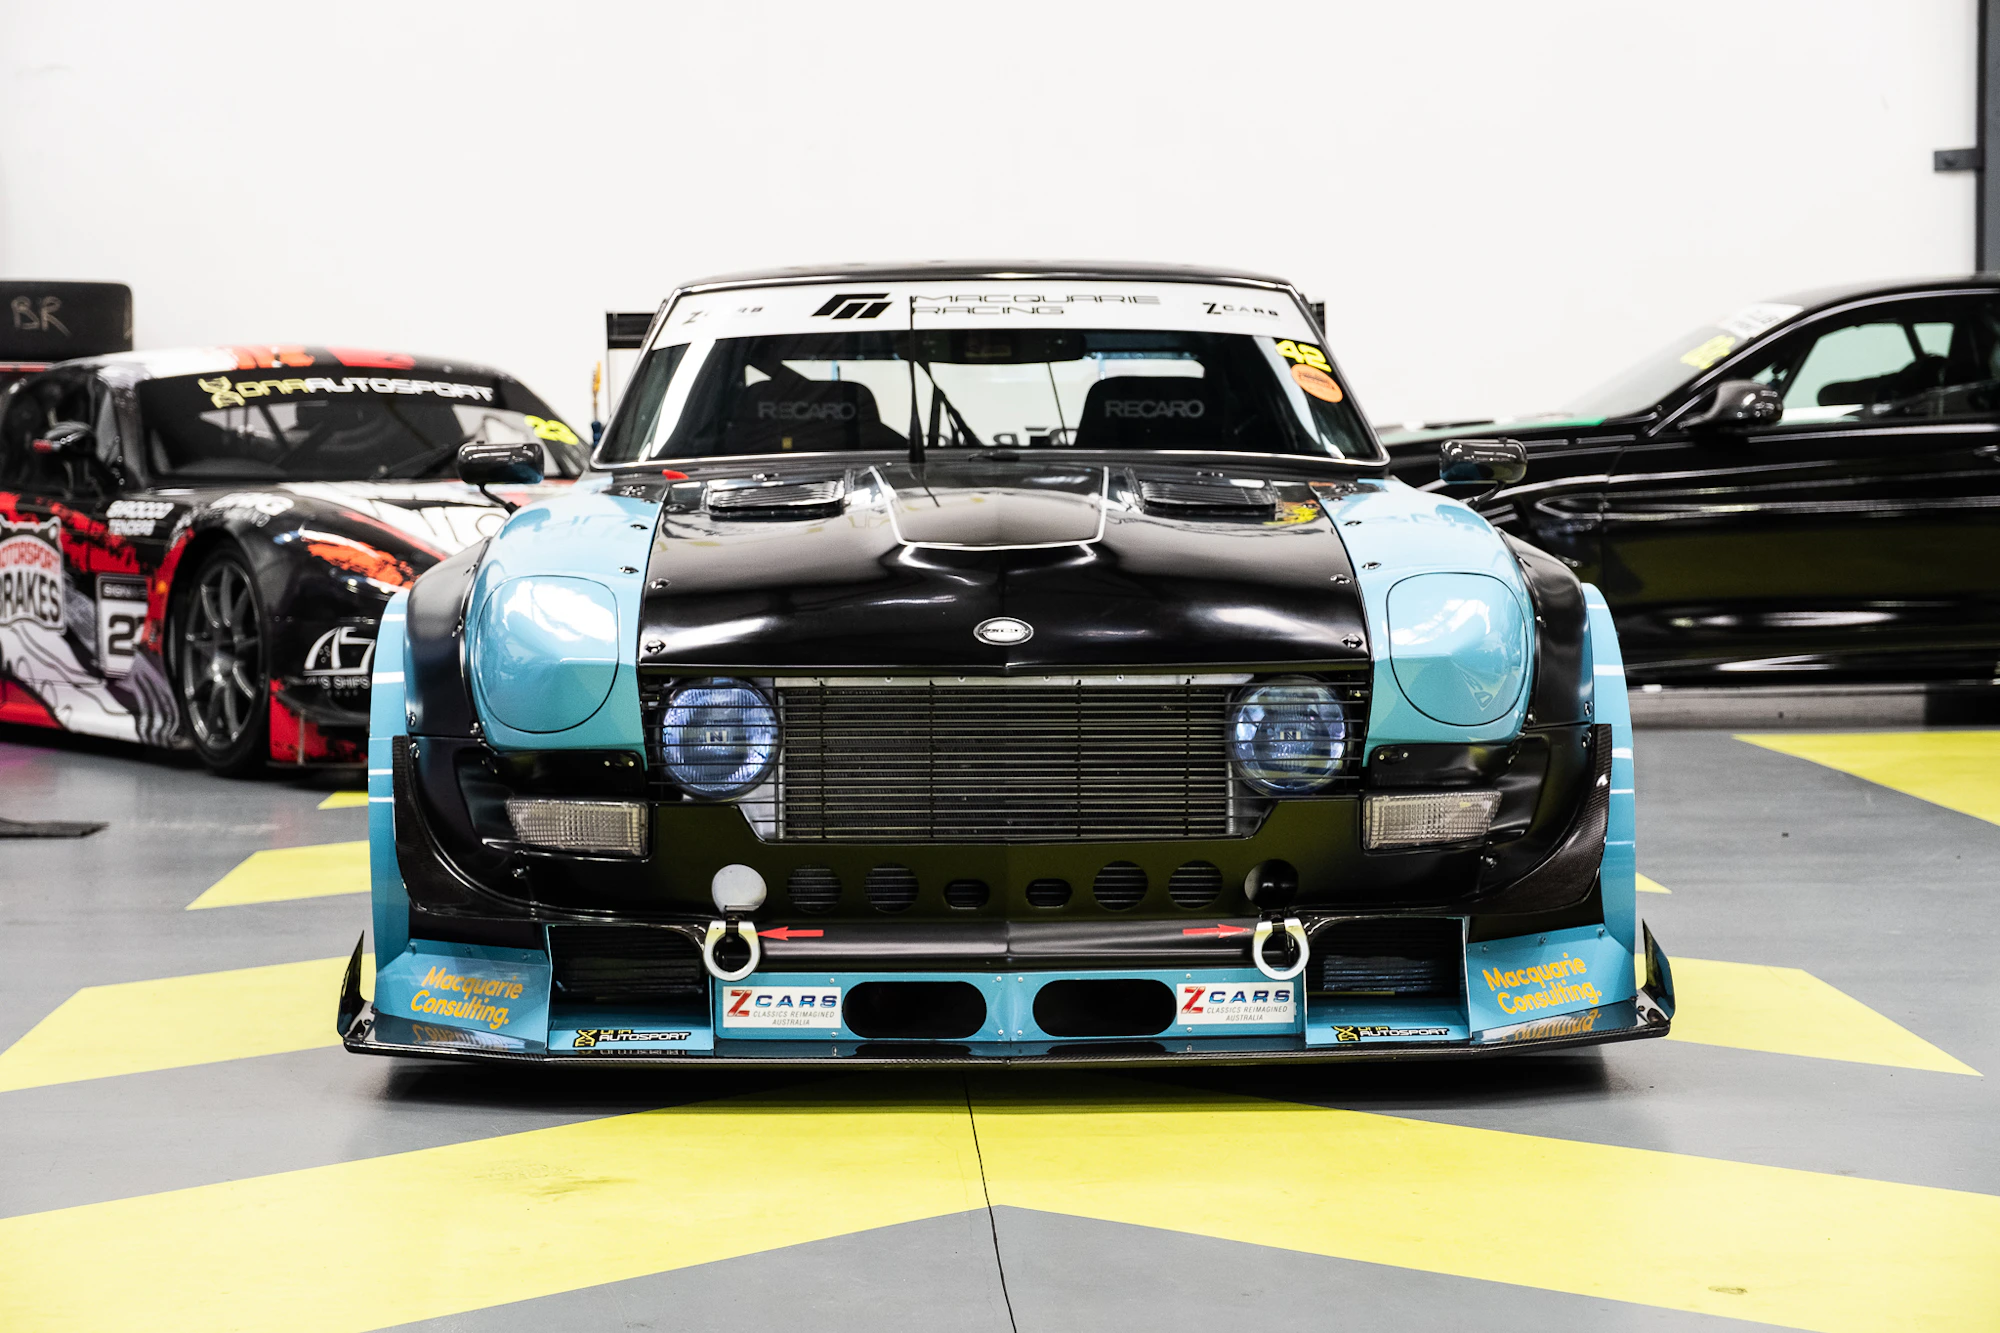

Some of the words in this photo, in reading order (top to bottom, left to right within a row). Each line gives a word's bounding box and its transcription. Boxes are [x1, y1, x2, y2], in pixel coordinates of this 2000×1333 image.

[911, 294, 1160, 305] MACQUARIE
[911, 306, 1064, 315] RACING
[1274, 339, 1332, 373] 42
[757, 402, 856, 420] RECARO
[1104, 400, 1205, 418] RECARO
[0, 571, 62, 623] RAKES
[421, 966, 524, 1000] Macquarie
[1482, 952, 1587, 991] Macquarie
[410, 989, 510, 1030] Consulting.
[727, 989, 753, 1017] Z
[755, 995, 838, 1008] CARS
[1181, 986, 1206, 1014] Z
[1208, 990, 1290, 1004] CARS
[1497, 979, 1603, 1014] Consulting.
[1225, 1014, 1263, 1022] AUSTRALIA
[598, 1032, 690, 1042] AUTOSPORT
[1359, 1028, 1449, 1037] AUTOSPORT
